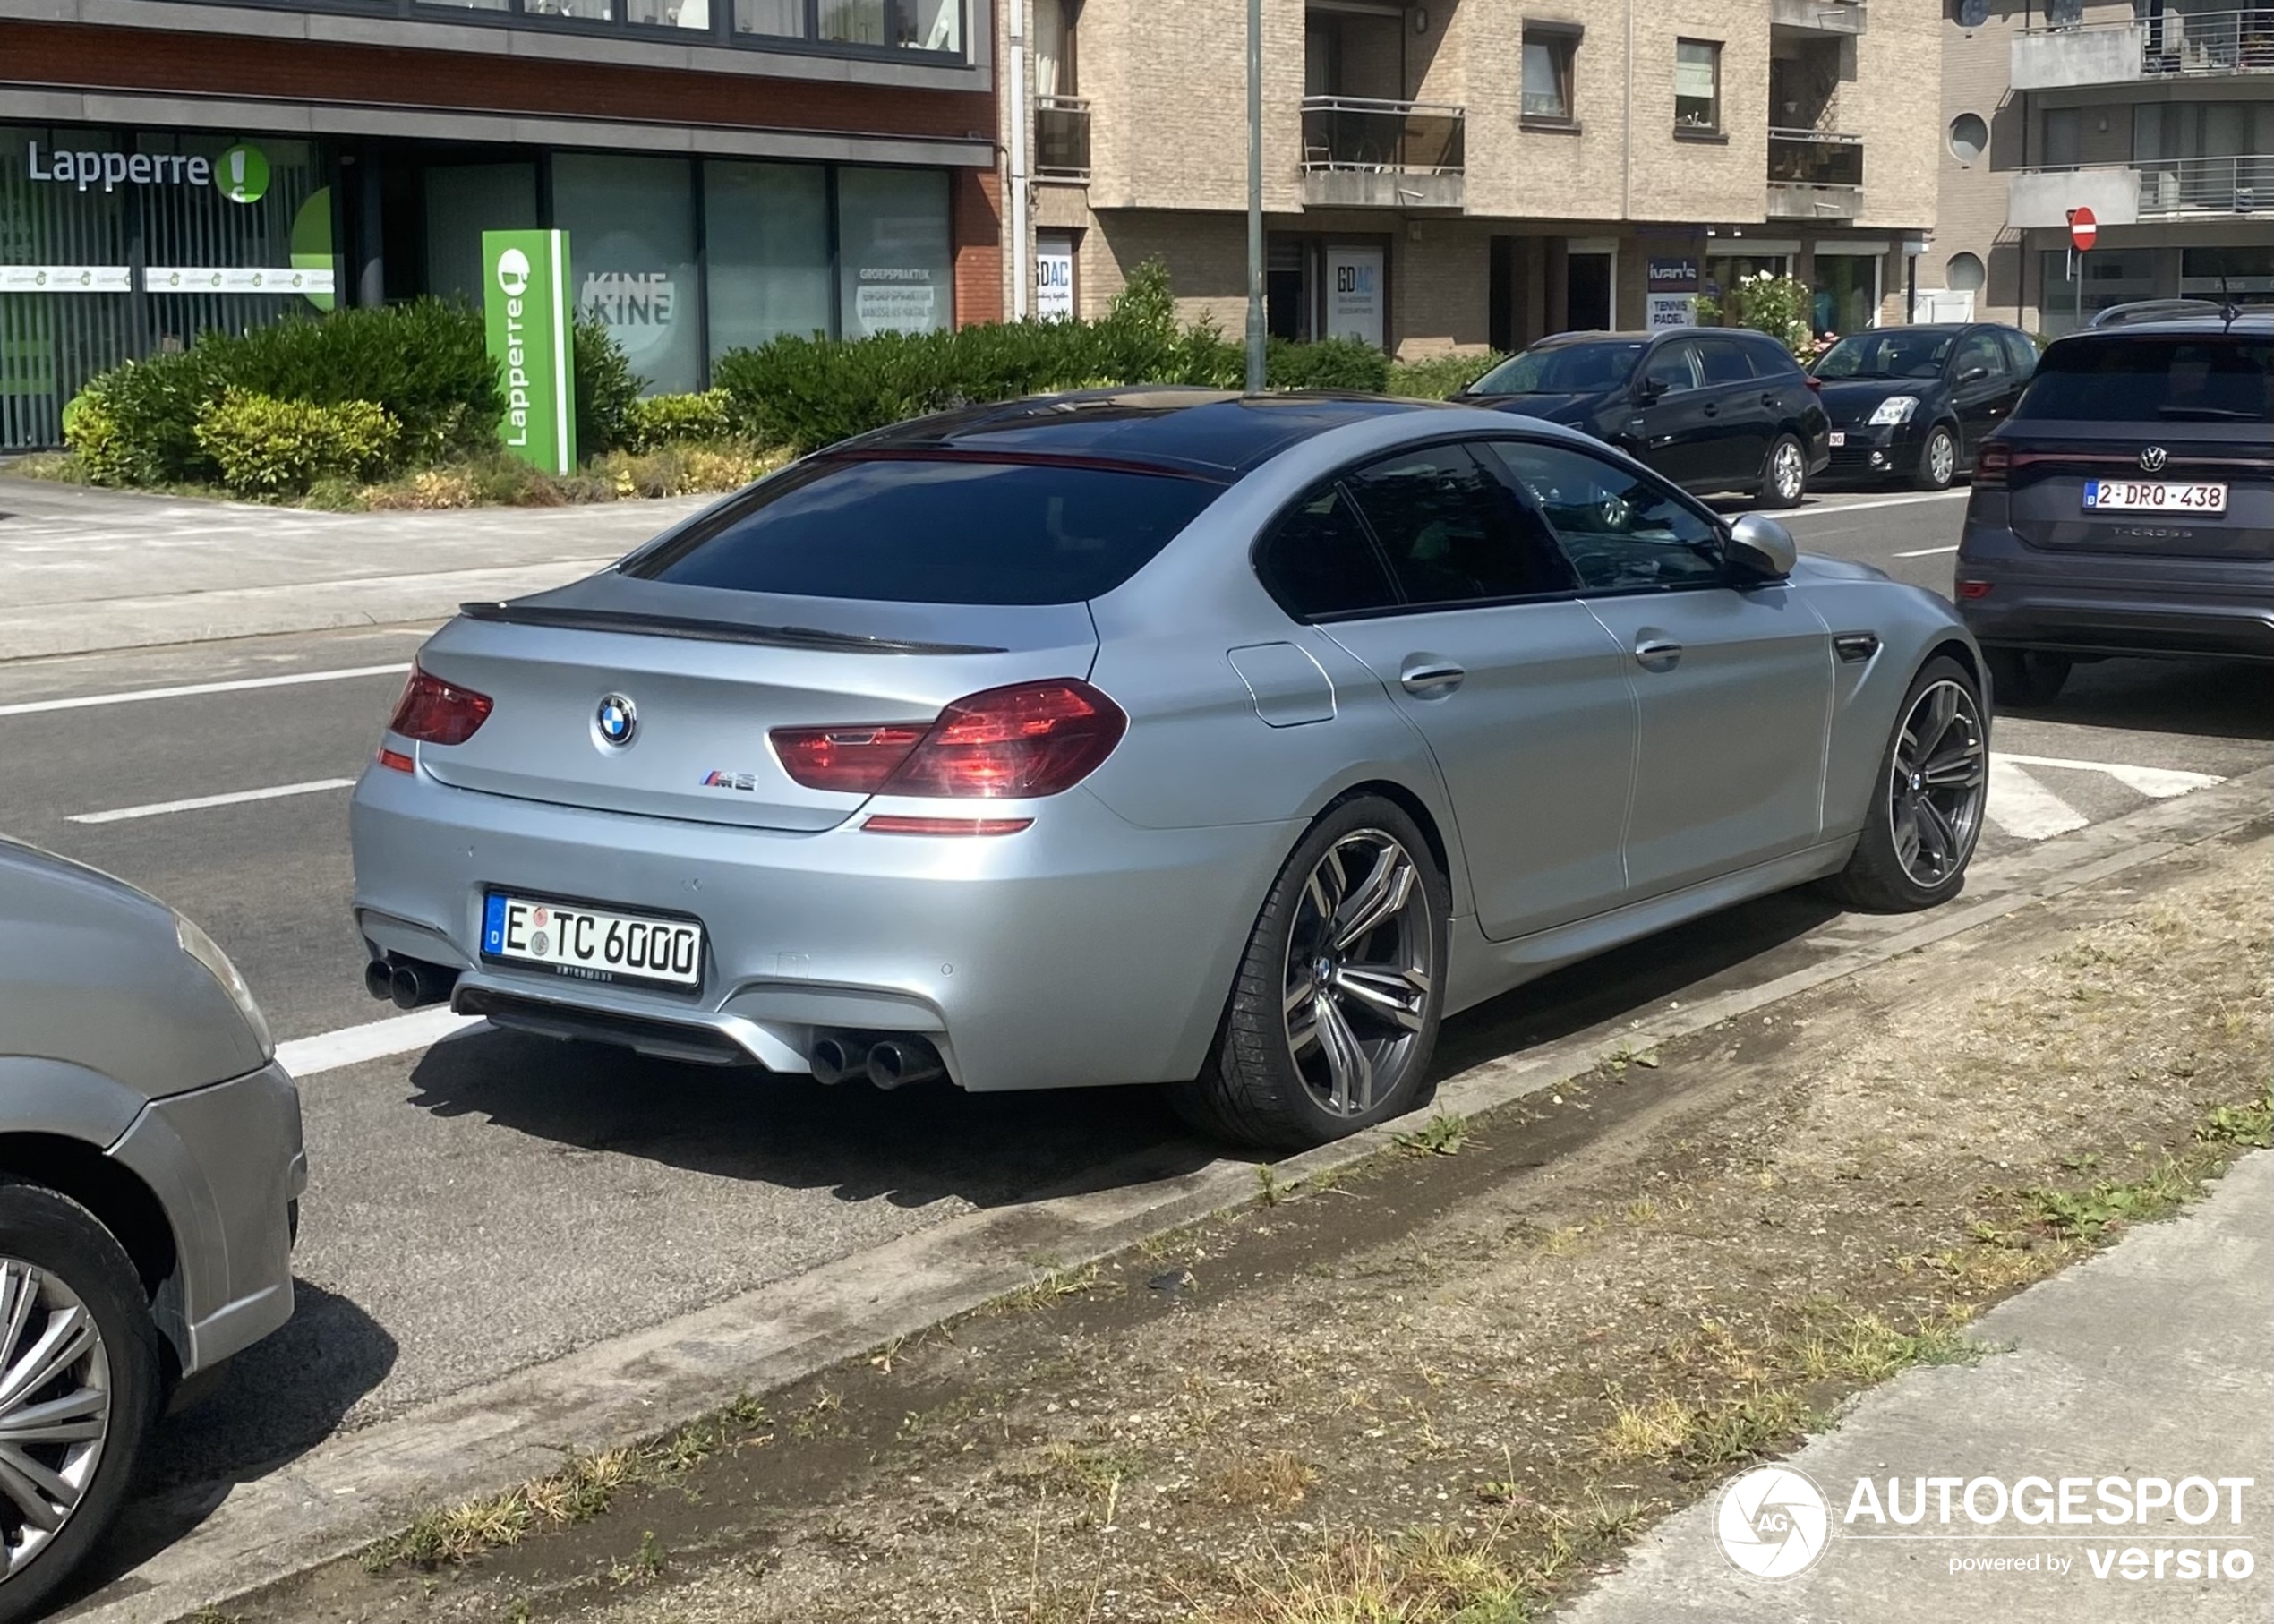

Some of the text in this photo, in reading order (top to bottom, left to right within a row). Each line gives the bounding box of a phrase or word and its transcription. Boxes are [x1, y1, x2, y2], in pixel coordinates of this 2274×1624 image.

[30, 141, 209, 192] Lapperre
[2214, 279, 2246, 290] Fcus
[1654, 300, 1688, 312] TENNIS
[1654, 314, 1685, 324] PADEL
[507, 298, 530, 446] Lapperre
[2087, 495, 2096, 506] B
[490, 905, 695, 975] D E TC 6000
